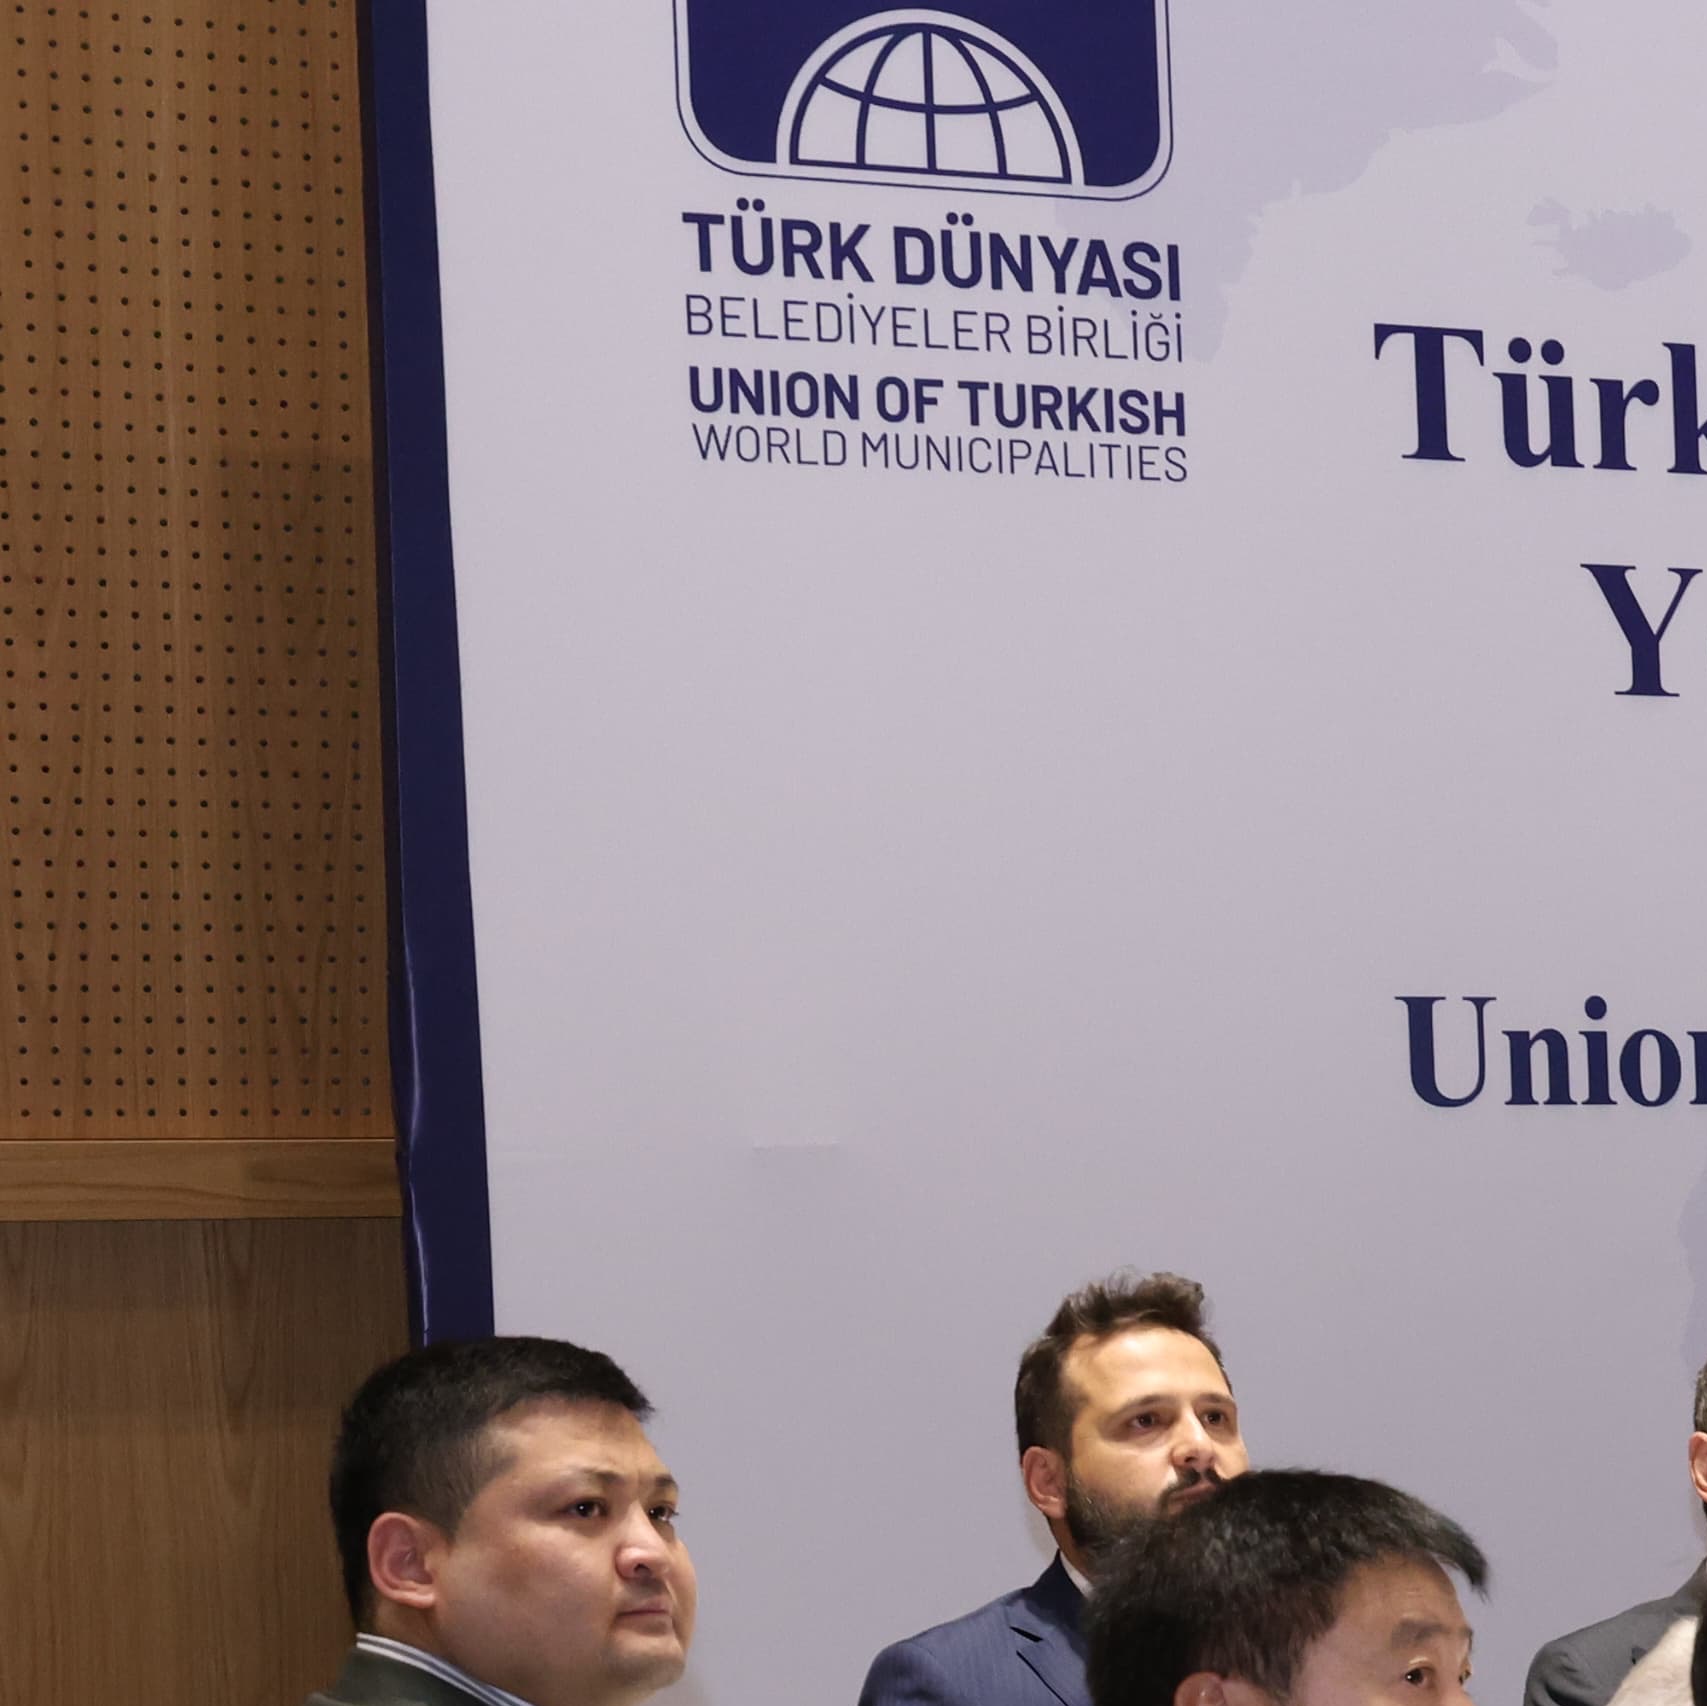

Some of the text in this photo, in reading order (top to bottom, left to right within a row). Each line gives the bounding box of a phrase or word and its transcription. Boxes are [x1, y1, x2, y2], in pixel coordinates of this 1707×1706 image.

[681, 197, 1182, 302] TÜRK DÜNYASI
[685, 293, 1184, 364] BELEDİYELER BİRLİĞİ
[688, 366, 1187, 436] UNION OF TURKISH
[691, 422, 1189, 483] WORLD MUNICIPALITIES
